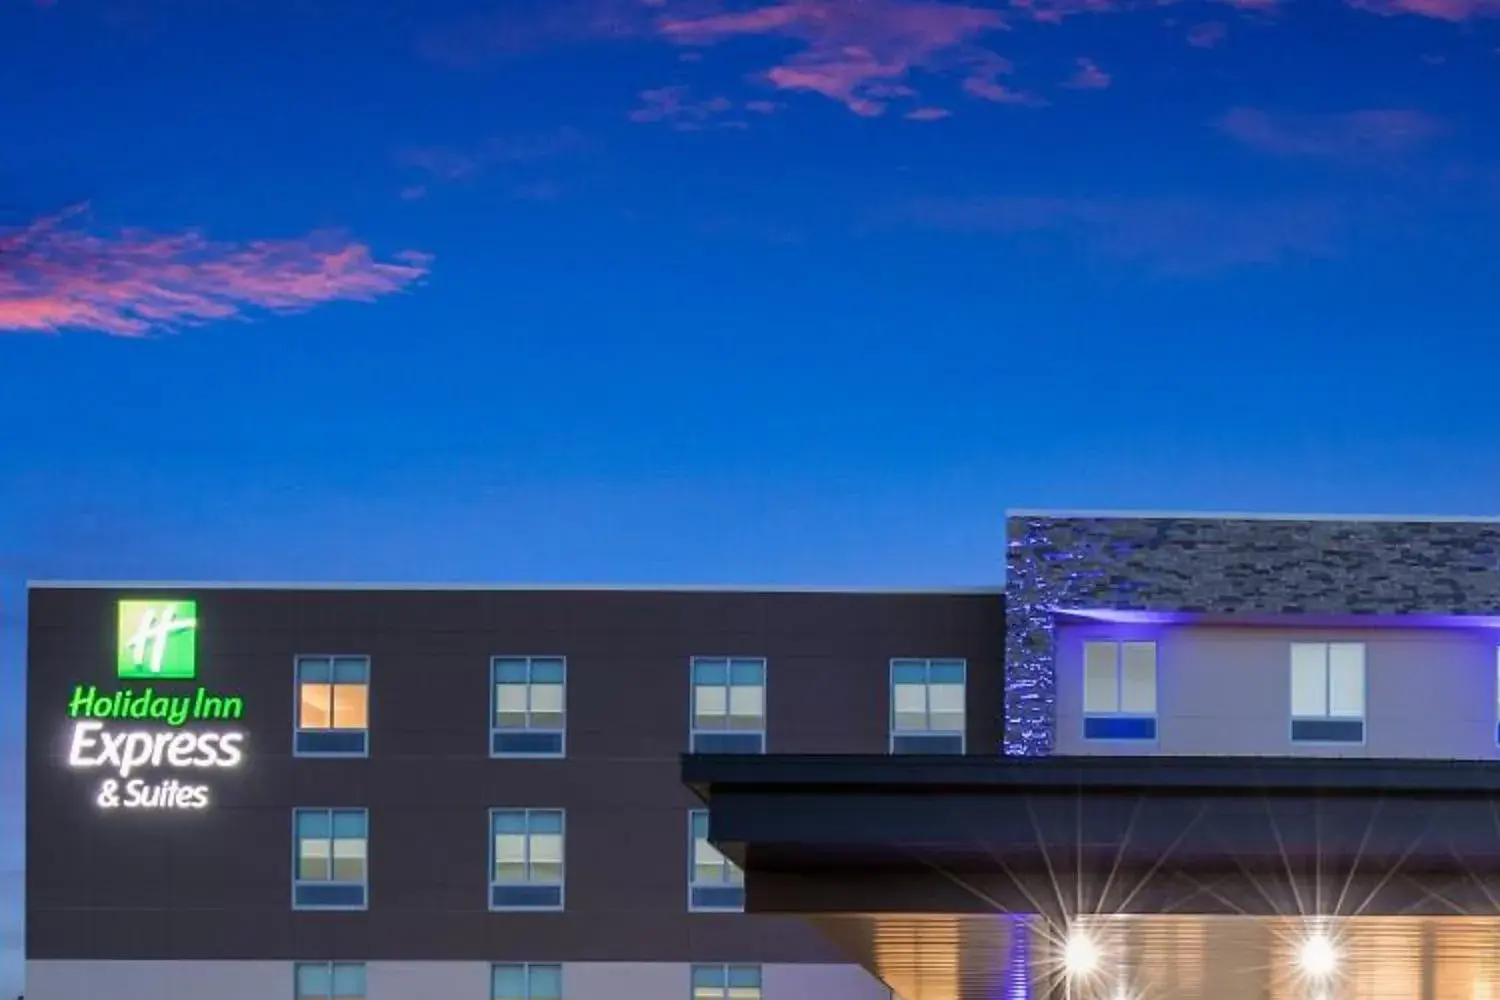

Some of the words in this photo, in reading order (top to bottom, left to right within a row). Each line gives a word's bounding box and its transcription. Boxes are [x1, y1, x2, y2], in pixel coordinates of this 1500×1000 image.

[69, 686, 189, 725] Holiday
[195, 688, 242, 718] Inn
[69, 722, 242, 777] Express
[98, 779, 119, 807] &
[124, 779, 208, 807] Suites
